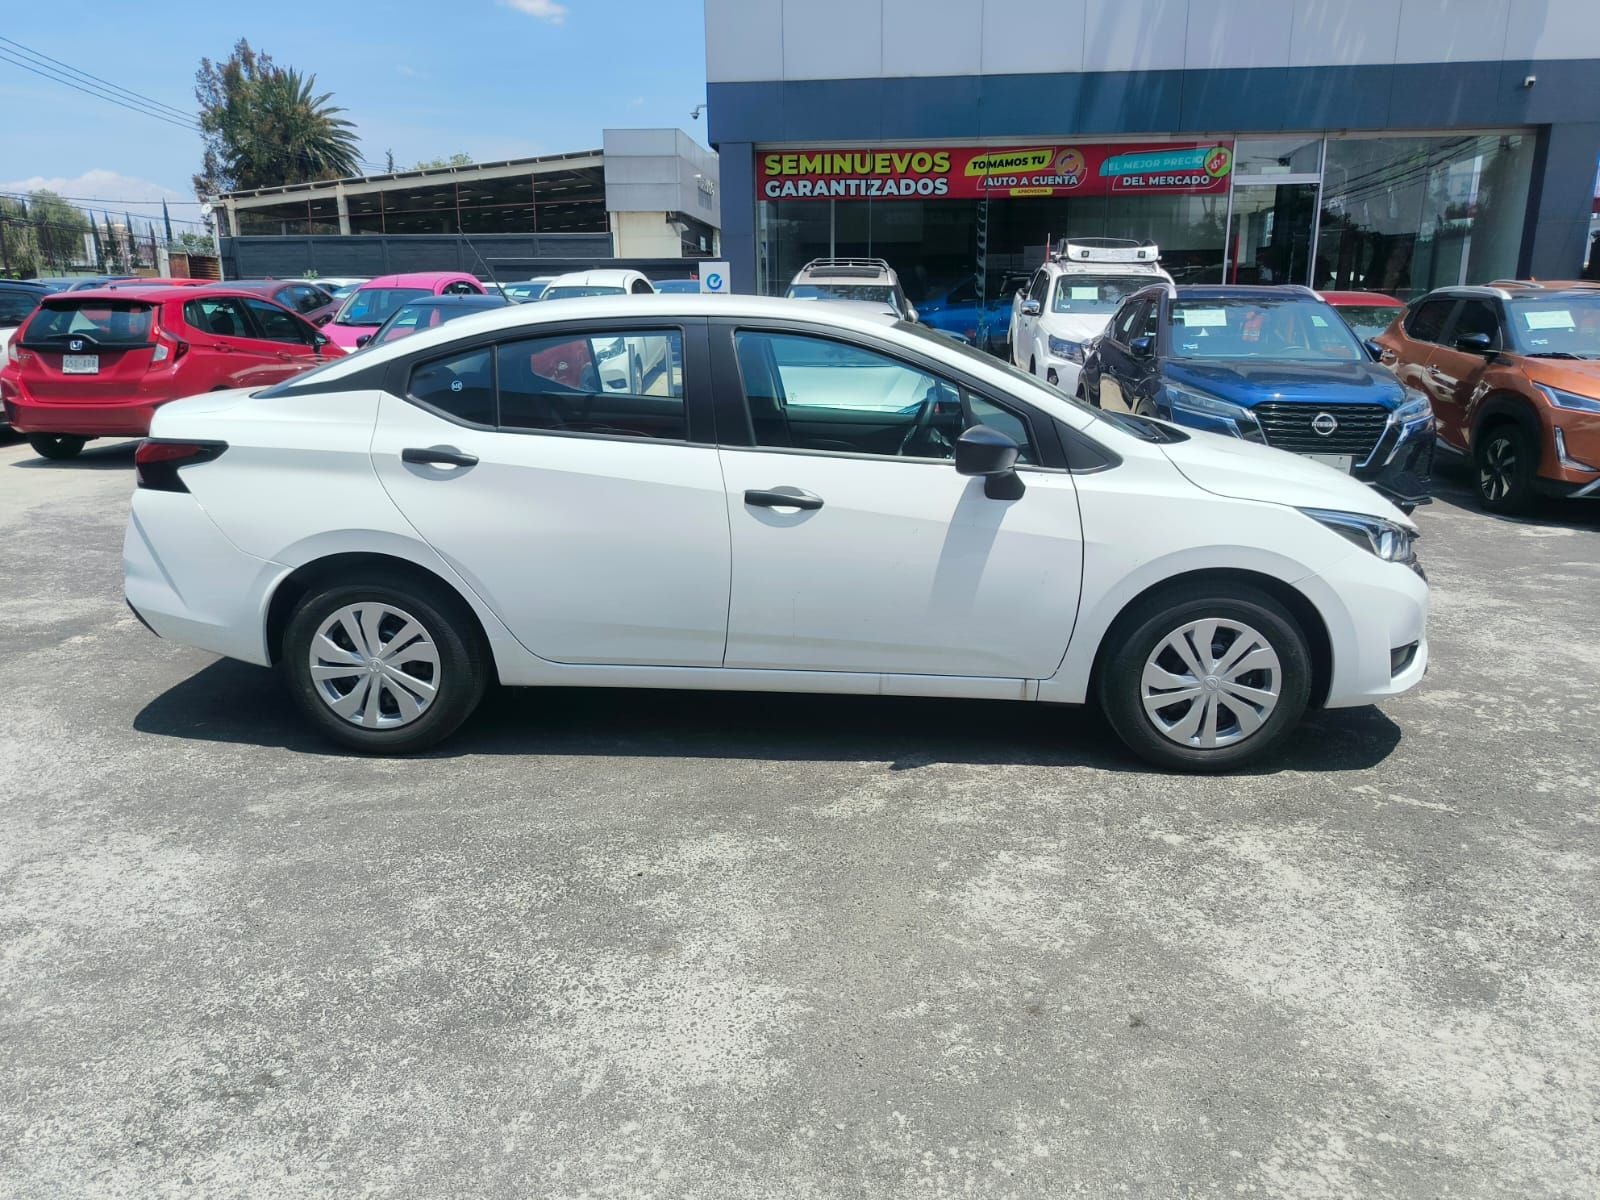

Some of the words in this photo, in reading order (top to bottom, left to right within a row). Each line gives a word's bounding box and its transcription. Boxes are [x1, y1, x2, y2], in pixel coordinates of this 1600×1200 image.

[764, 152, 951, 175] SEMINUEVOS
[972, 157, 1028, 170] TOMAMOS
[1031, 156, 1045, 164] TU
[1108, 163, 1120, 171] EL
[1123, 159, 1160, 169] MEJOR
[1162, 155, 1204, 167] PRECIO
[765, 177, 949, 197] GARANTIZADOS
[983, 176, 1018, 186] AUTO
[1020, 176, 1029, 185] A
[1032, 175, 1078, 185] CUENTA
[1123, 176, 1145, 186] DEL
[1148, 175, 1210, 185] MERCADO
